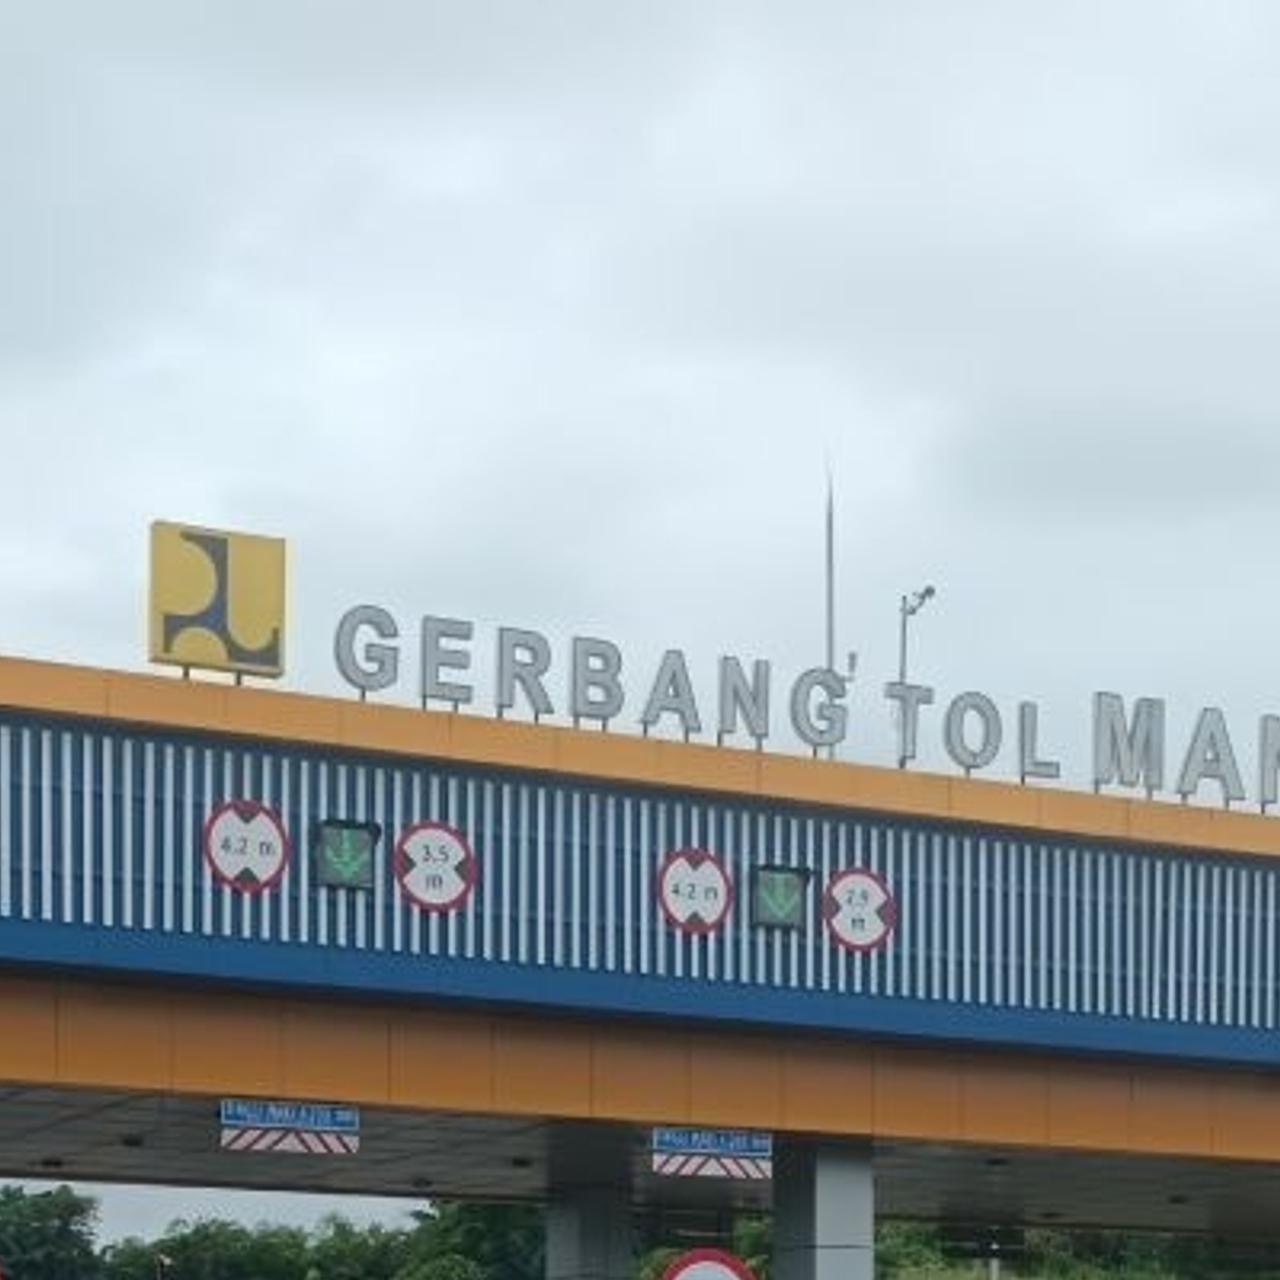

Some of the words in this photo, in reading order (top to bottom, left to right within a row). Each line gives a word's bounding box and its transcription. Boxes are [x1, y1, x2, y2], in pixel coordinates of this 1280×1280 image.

[334, 605, 848, 749] GERBANG
[884, 681, 1061, 779] TOL
[422, 845, 449, 863] 3.5
